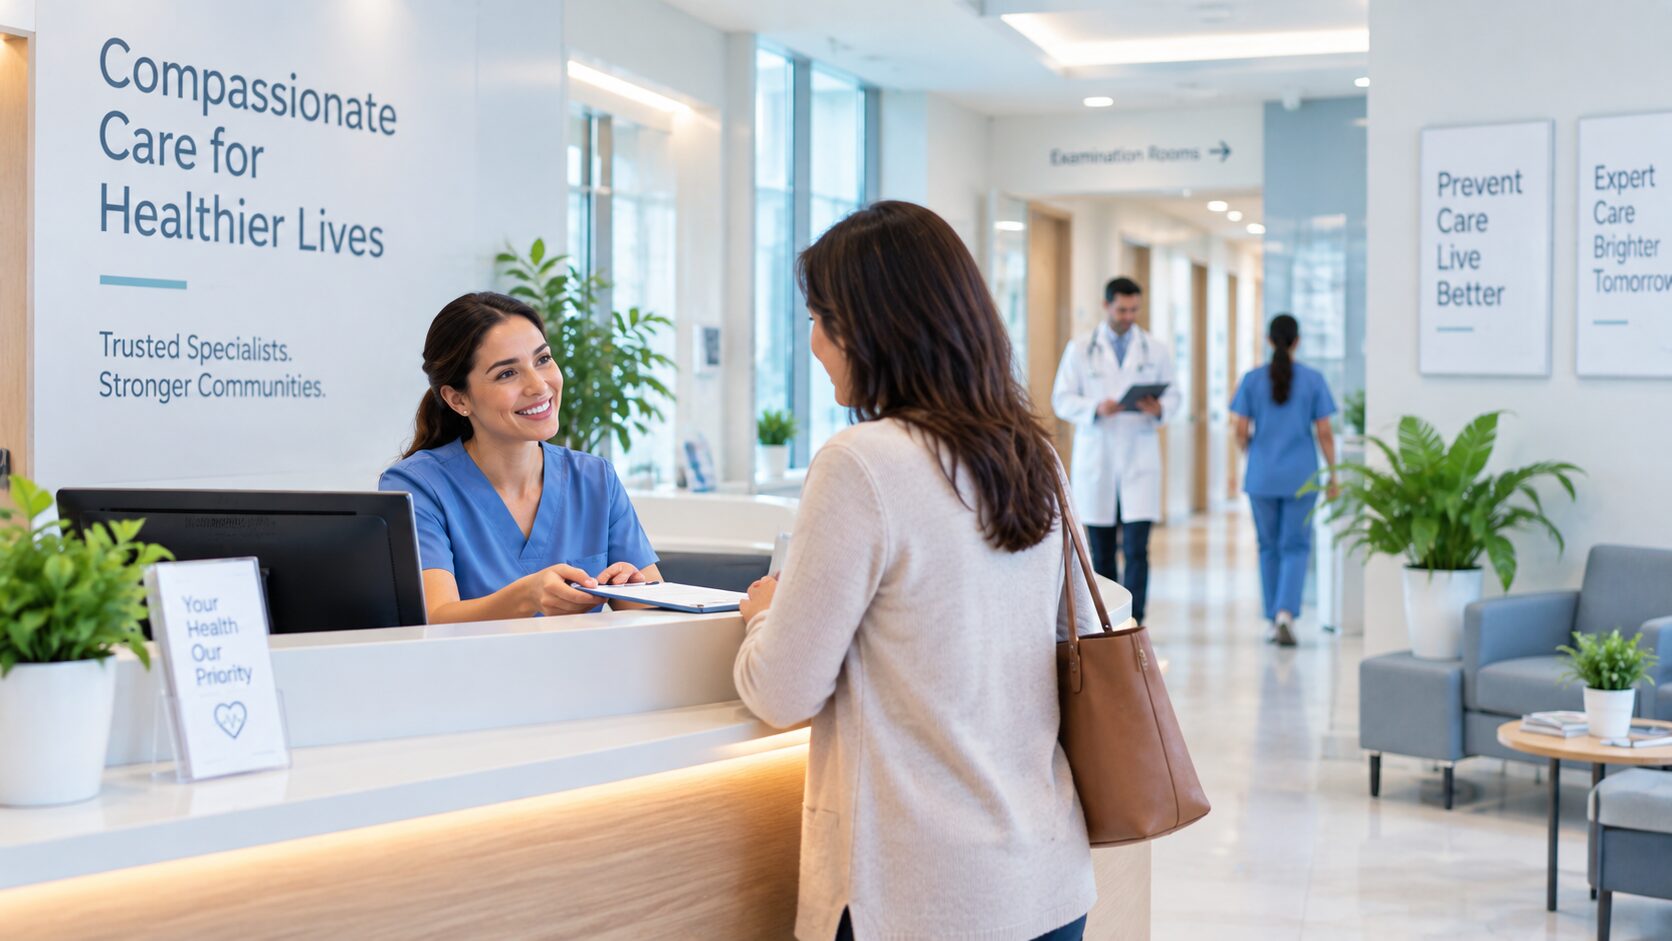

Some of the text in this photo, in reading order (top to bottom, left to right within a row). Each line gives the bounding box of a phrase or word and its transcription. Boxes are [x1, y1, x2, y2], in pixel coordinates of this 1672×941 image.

[100, 38, 397, 137] Compassionate
[99, 110, 264, 178] Care for
[1050, 145, 1201, 167] Examination Rooms
[1437, 169, 1523, 198] Prevent
[1594, 164, 1656, 195] Expert
[100, 183, 384, 258] Healthier Lives
[1437, 207, 1489, 234] Care
[1593, 199, 1636, 226] Care
[1437, 244, 1481, 271] Live
[1594, 234, 1661, 265] Brighter
[1437, 281, 1505, 307] Better
[99, 331, 293, 366] Trusted Specialists.
[99, 371, 326, 404] Stronger Communities.
[182, 595, 219, 613] Your
[187, 617, 239, 638] Health
[191, 643, 222, 663] Our
[195, 666, 253, 686] Priority
